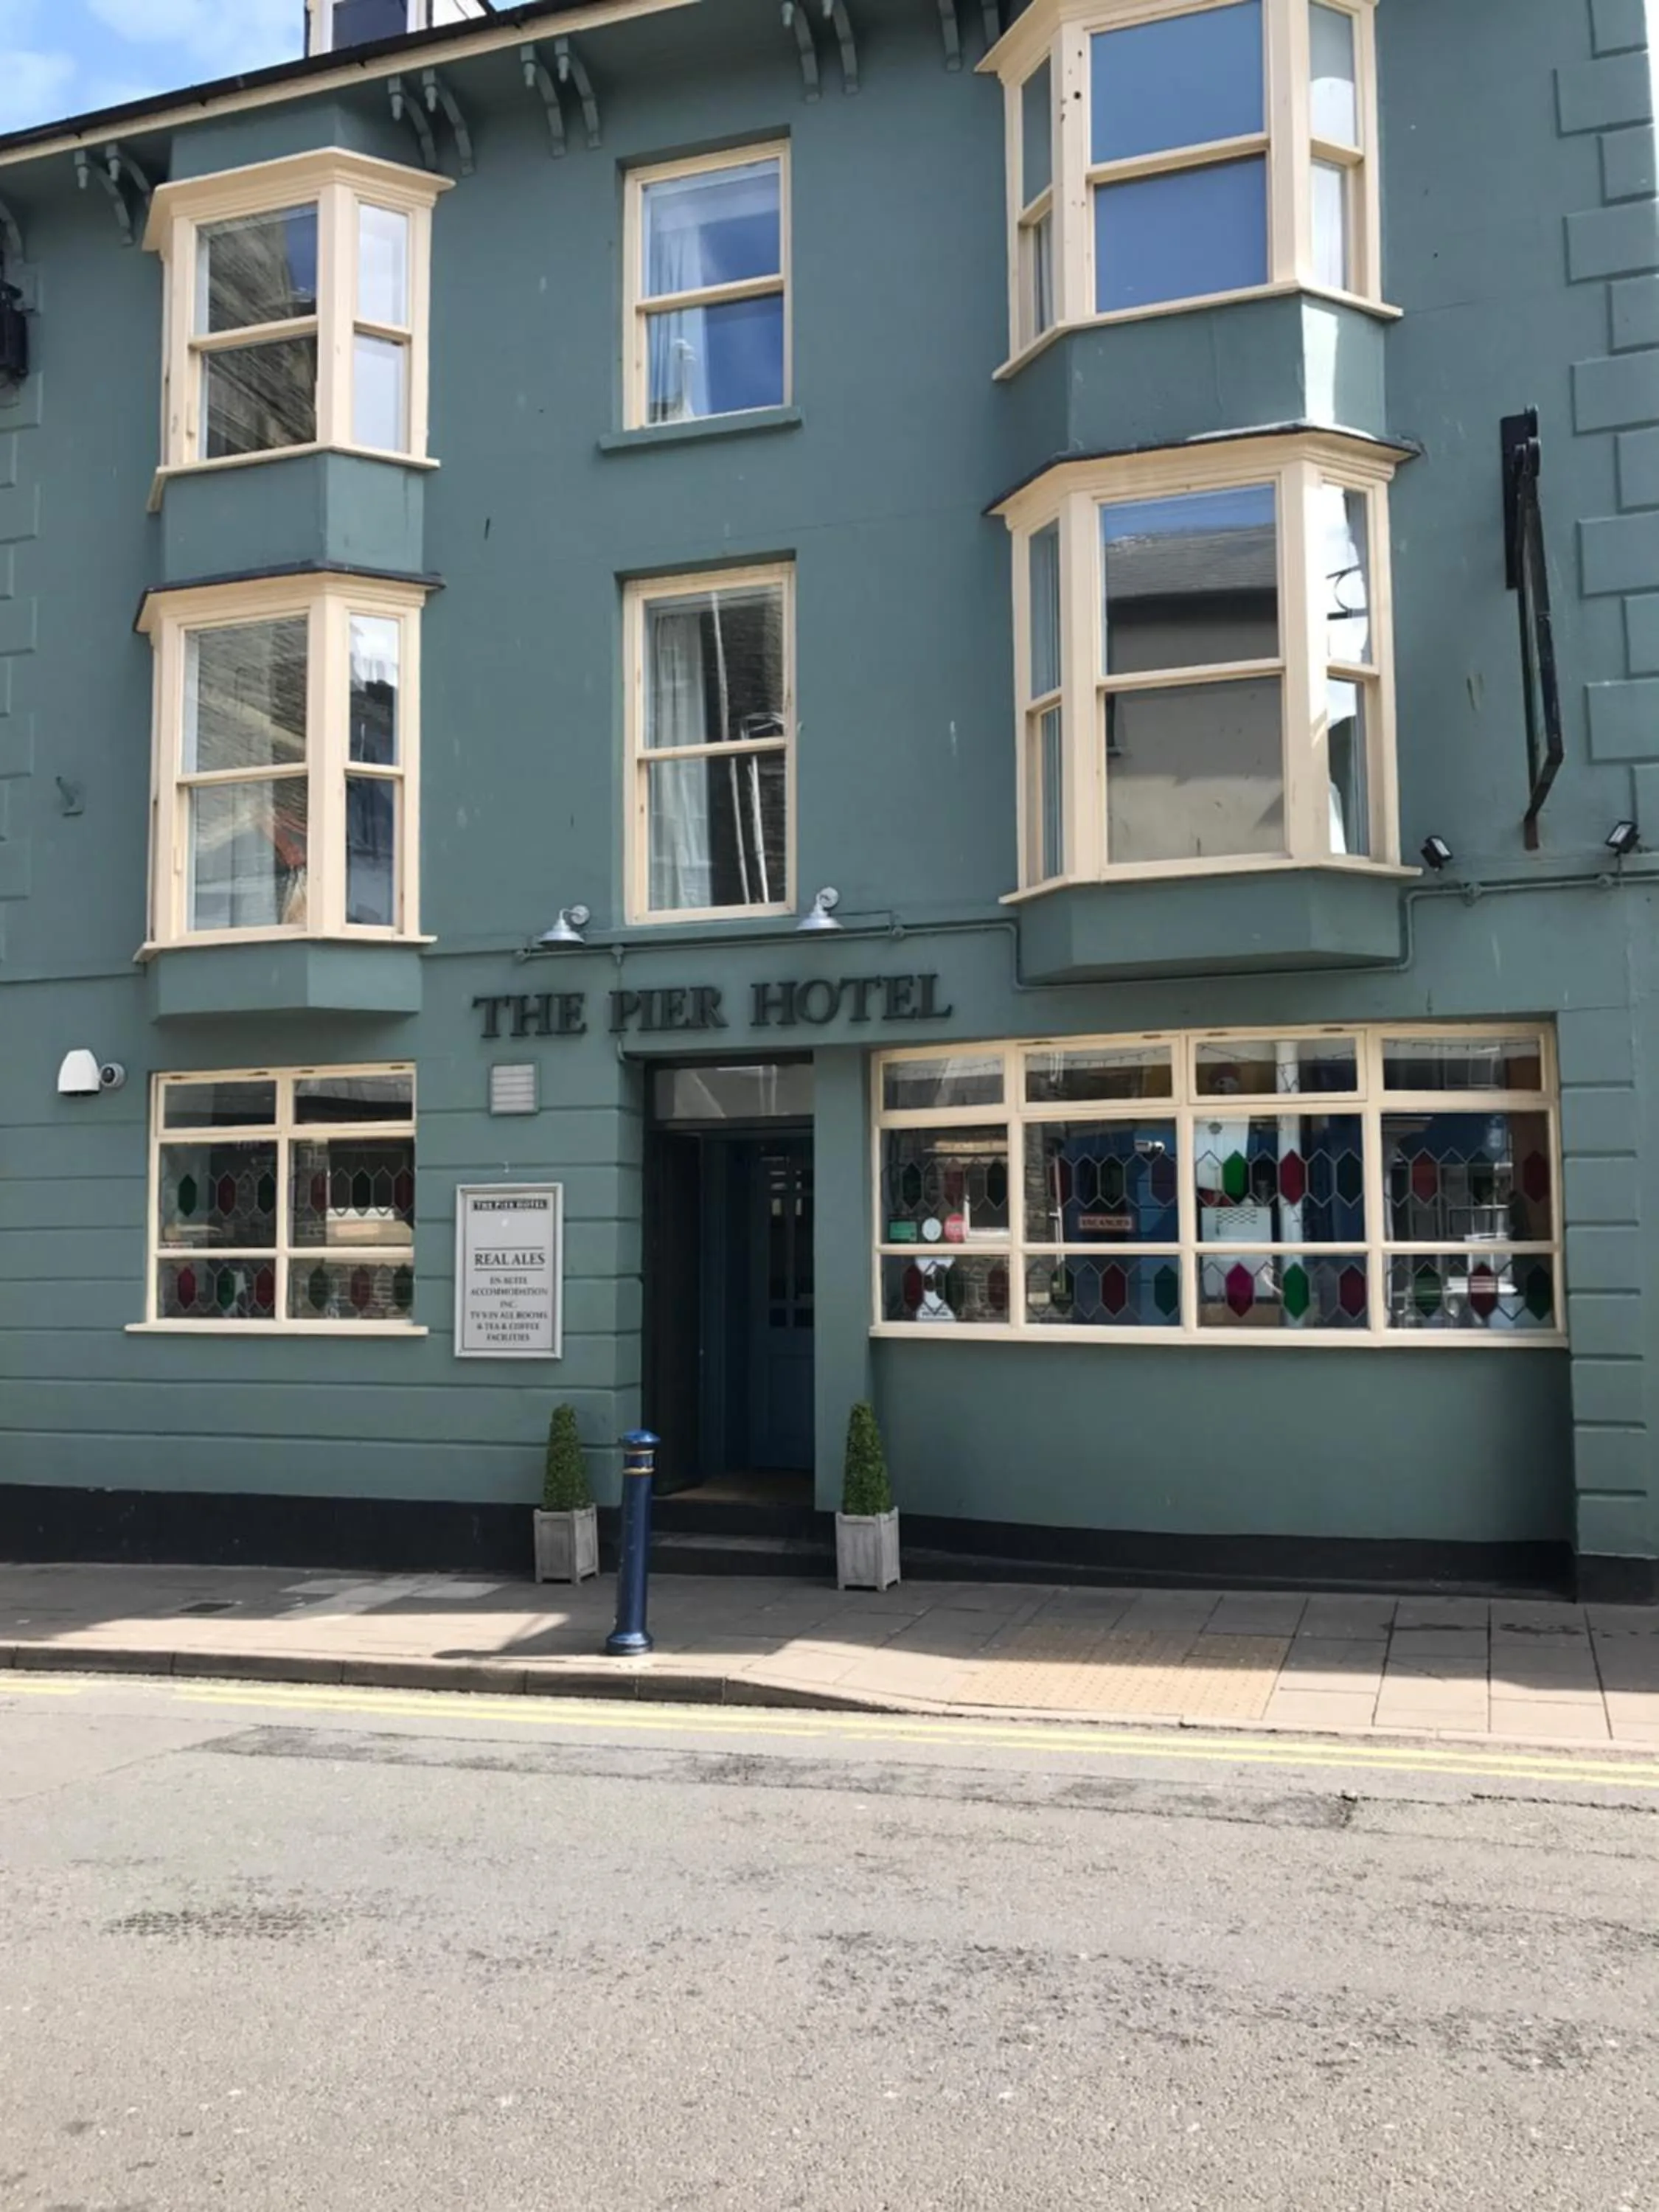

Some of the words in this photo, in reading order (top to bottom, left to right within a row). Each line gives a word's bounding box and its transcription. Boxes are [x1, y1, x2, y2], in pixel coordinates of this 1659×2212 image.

[472, 992, 588, 1038] THE
[608, 986, 729, 1033] PIER
[749, 973, 953, 1027] HOTEL
[475, 1253, 509, 1265] REAL
[511, 1252, 546, 1265] ALES
[470, 1287, 549, 1296] ACCOMMODATION
[487, 1332, 530, 1342] FACILITIES
